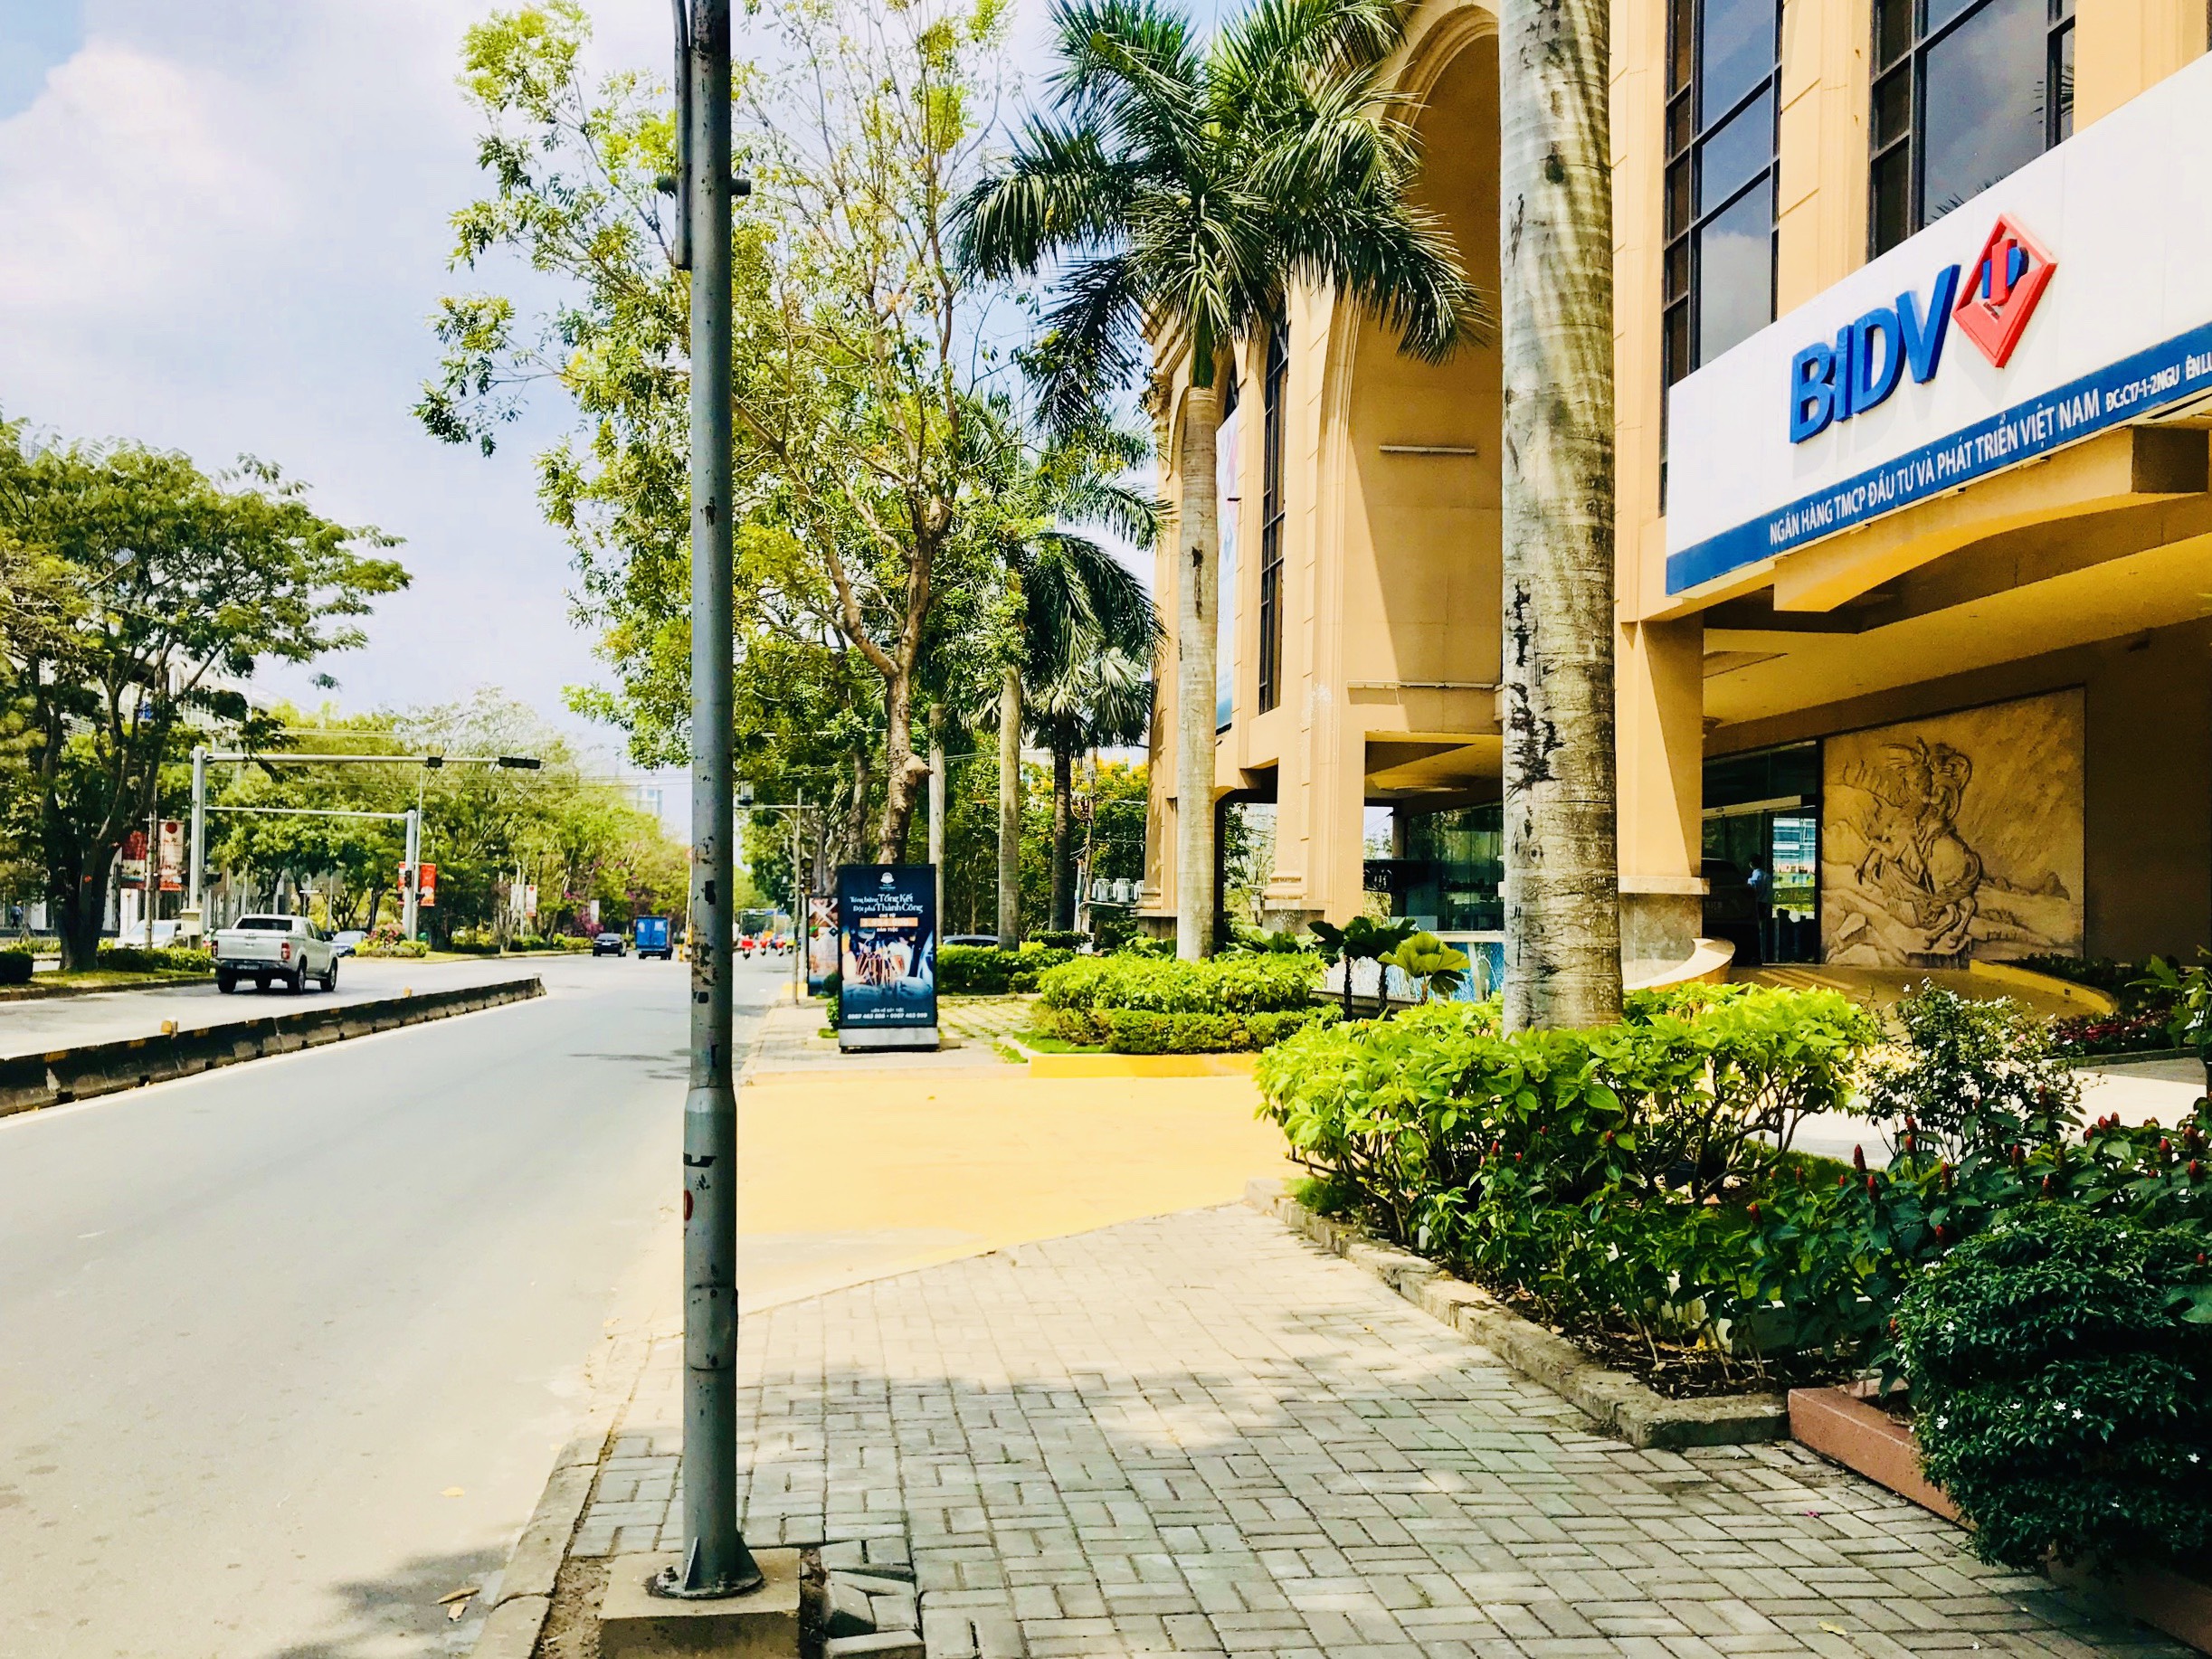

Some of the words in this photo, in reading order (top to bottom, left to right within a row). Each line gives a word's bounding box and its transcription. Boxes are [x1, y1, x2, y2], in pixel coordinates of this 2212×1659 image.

[1790, 263, 1961, 444] BIDV
[1770, 511, 1799, 545] NGÂN
[1801, 501, 1833, 534] HÀNG
[1834, 486, 1865, 520] TMCP
[1867, 469, 1895, 507] ĐẦU
[1896, 460, 1915, 495] TƯ
[1916, 450, 1935, 488] VÀ
[1937, 436, 1973, 479] PHÁT
[1975, 412, 2018, 464] TRIỂN
[2019, 403, 2055, 448] VIỆT
[2058, 388, 2101, 431] NAM
